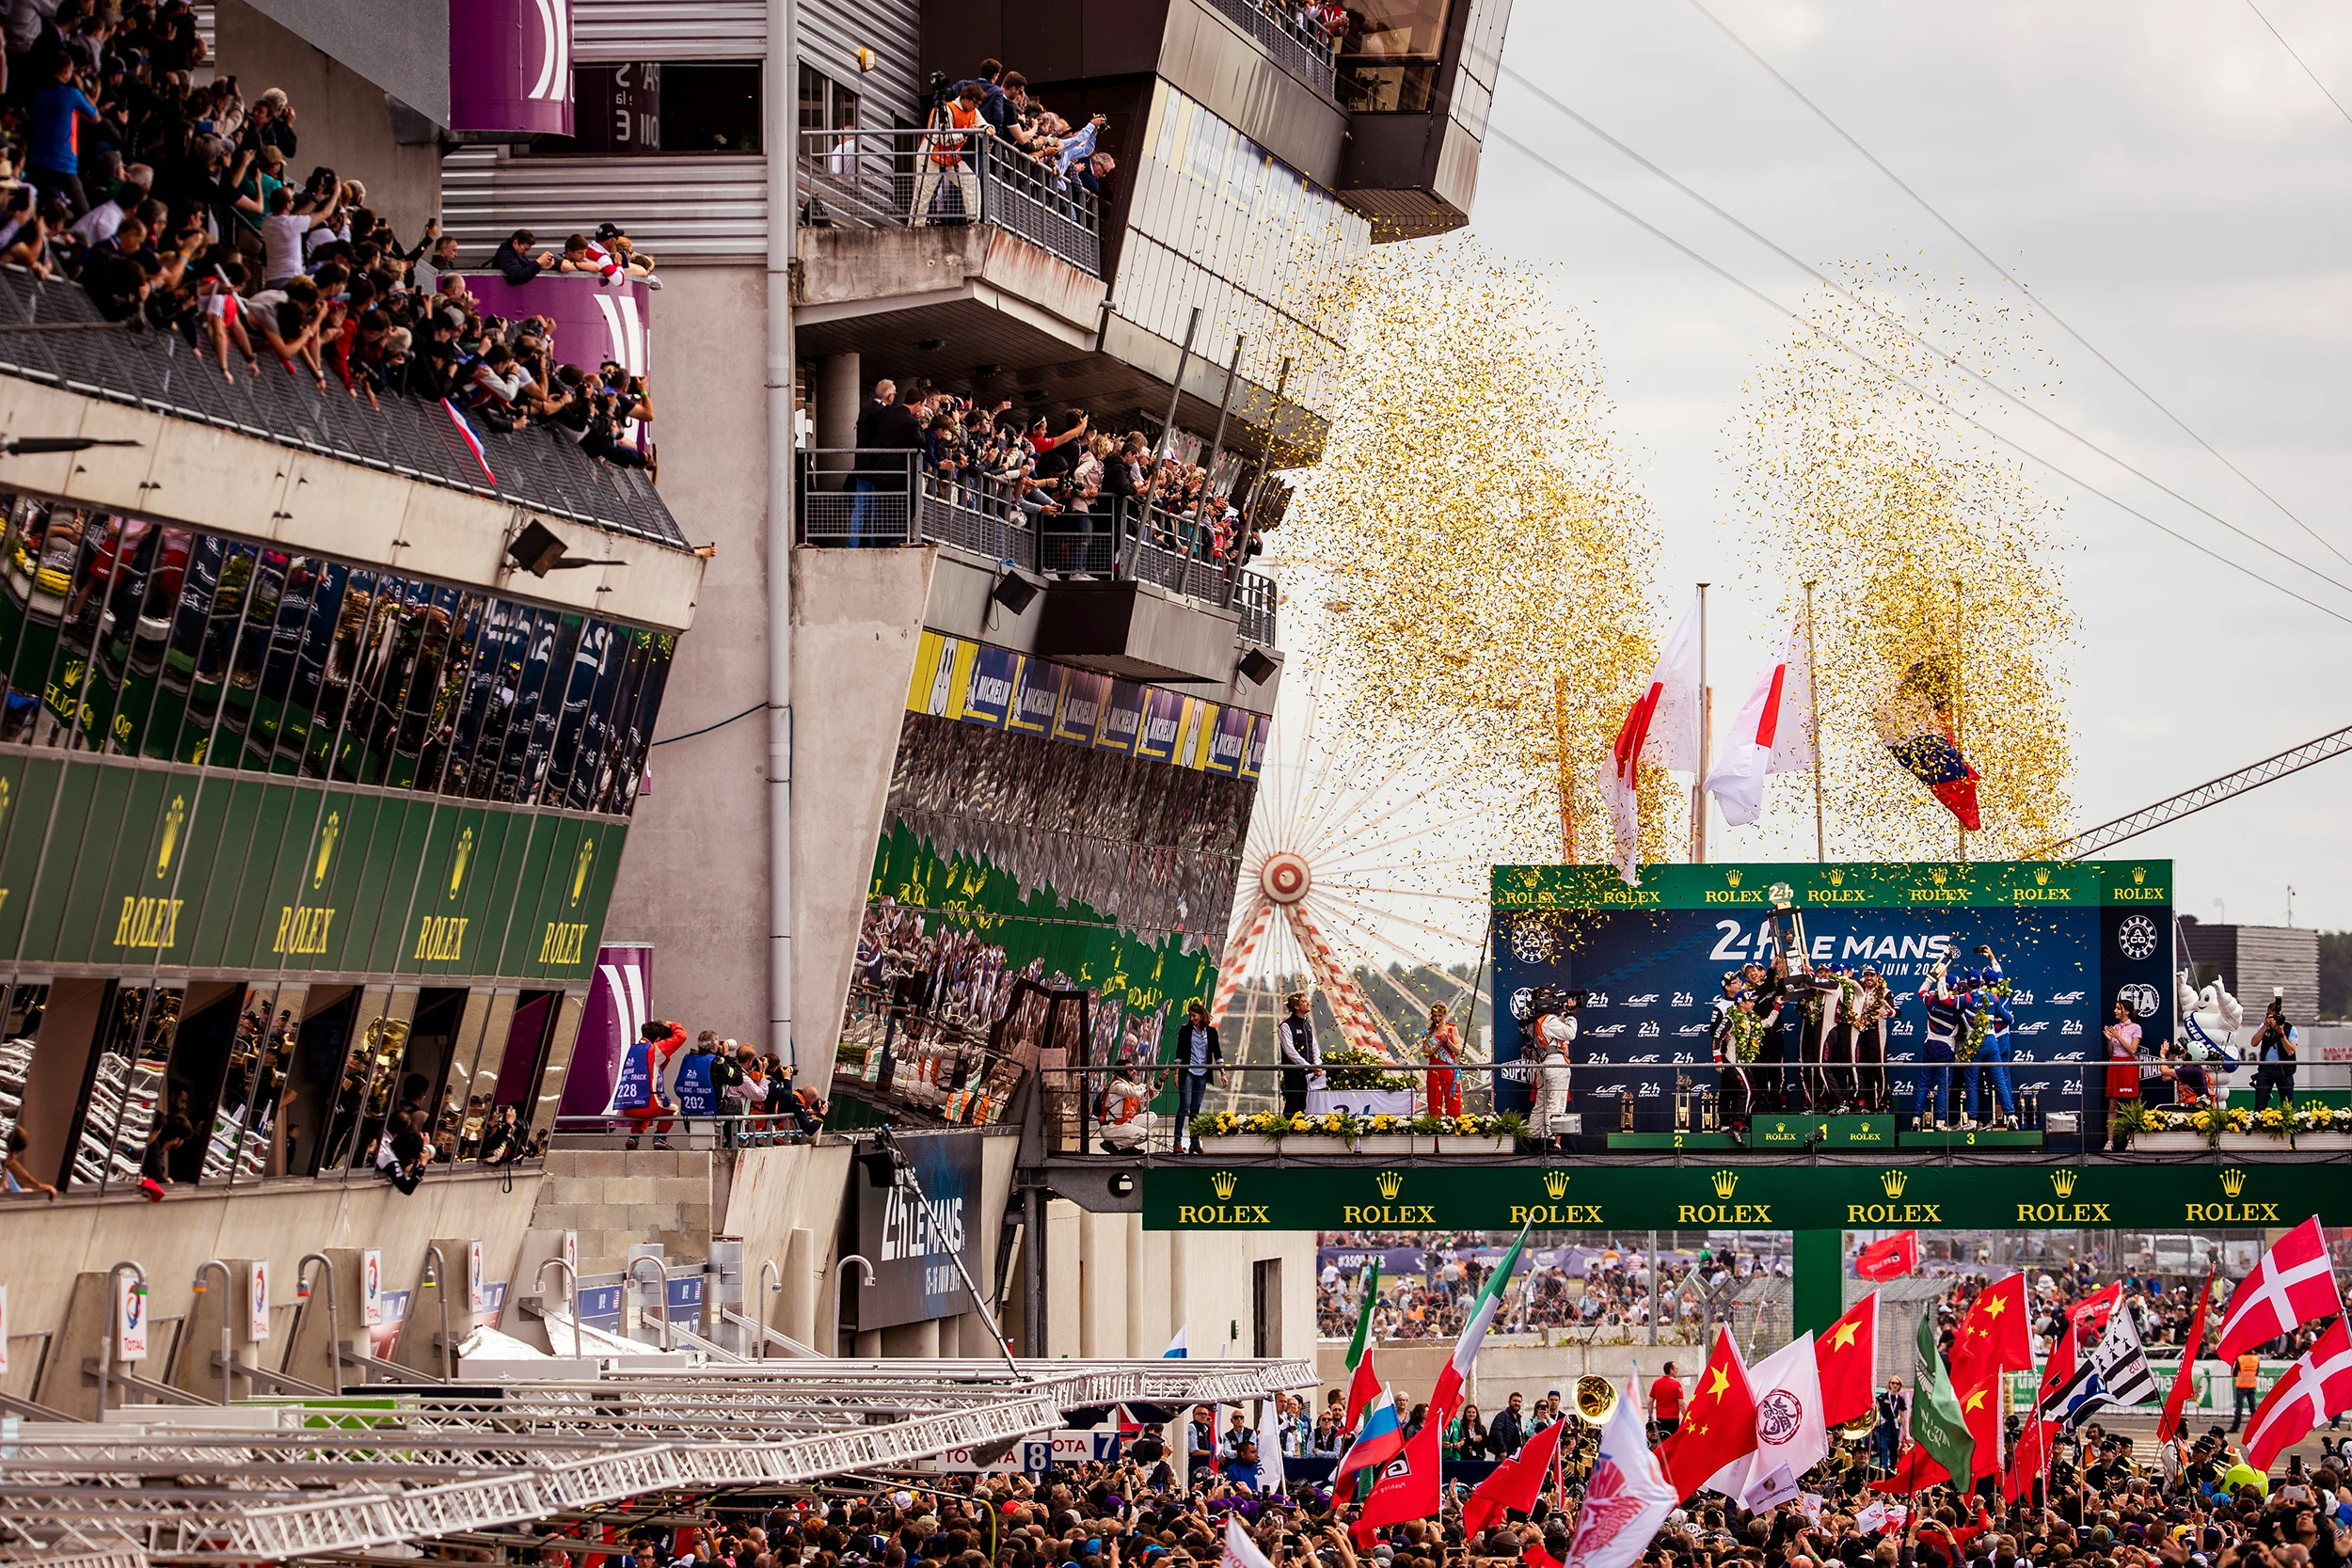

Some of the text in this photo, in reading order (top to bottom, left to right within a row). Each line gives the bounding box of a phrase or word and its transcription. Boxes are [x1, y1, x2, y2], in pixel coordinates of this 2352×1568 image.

[977, 675, 1012, 706] MICHELIN
[1023, 687, 1057, 717] MICHELIN
[1067, 698, 1099, 726] MICHELIN
[1108, 706, 1140, 735] MICHELIN
[1149, 717, 1178, 743] MICHELIN
[1217, 733, 1244, 758] MICHELIN
[1506, 892, 1558, 903] ROLEX
[1603, 892, 1661, 903] ROLEX
[1705, 891, 1763, 902] ROLEX
[1807, 890, 1866, 901] ROLEX
[1910, 889, 1969, 901] ROLEX
[2013, 888, 2071, 900] ROLEX
[2114, 888, 2164, 899] ROLEX
[113, 895, 184, 948] ROLEX
[272, 906, 336, 954] ROLEX
[414, 915, 469, 960] ROLEX
[538, 922, 588, 964] ROLEX
[1841, 935, 1950, 959] MANS
[1881, 963, 1913, 976] JUIN
[617, 1083, 638, 1099] 228
[684, 1096, 706, 1110] 202
[1674, 1135, 1683, 1148] 2
[1765, 1132, 1796, 1141] ROLEX
[1850, 1132, 1881, 1141] ROLEX
[1966, 1132, 1976, 1146] 3
[1179, 1205, 1270, 1224] ROLEX
[1343, 1205, 1436, 1224] ROLEX
[1510, 1205, 1603, 1224] ROLEX
[1678, 1205, 1772, 1224] ROLEX
[1848, 1204, 1941, 1223] ROLEX
[2017, 1203, 2110, 1222] ROLEX
[2185, 1203, 2279, 1222] ROLEX
[909, 1201, 925, 1257] LE
[927, 1197, 962, 1256] MANS
[366, 1306, 380, 1319] TOTAL
[252, 1320, 268, 1333] TOTAL
[124, 1338, 145, 1351] TOTAL
[1099, 1433, 1115, 1459] 7
[1029, 1443, 1046, 1470] 8
